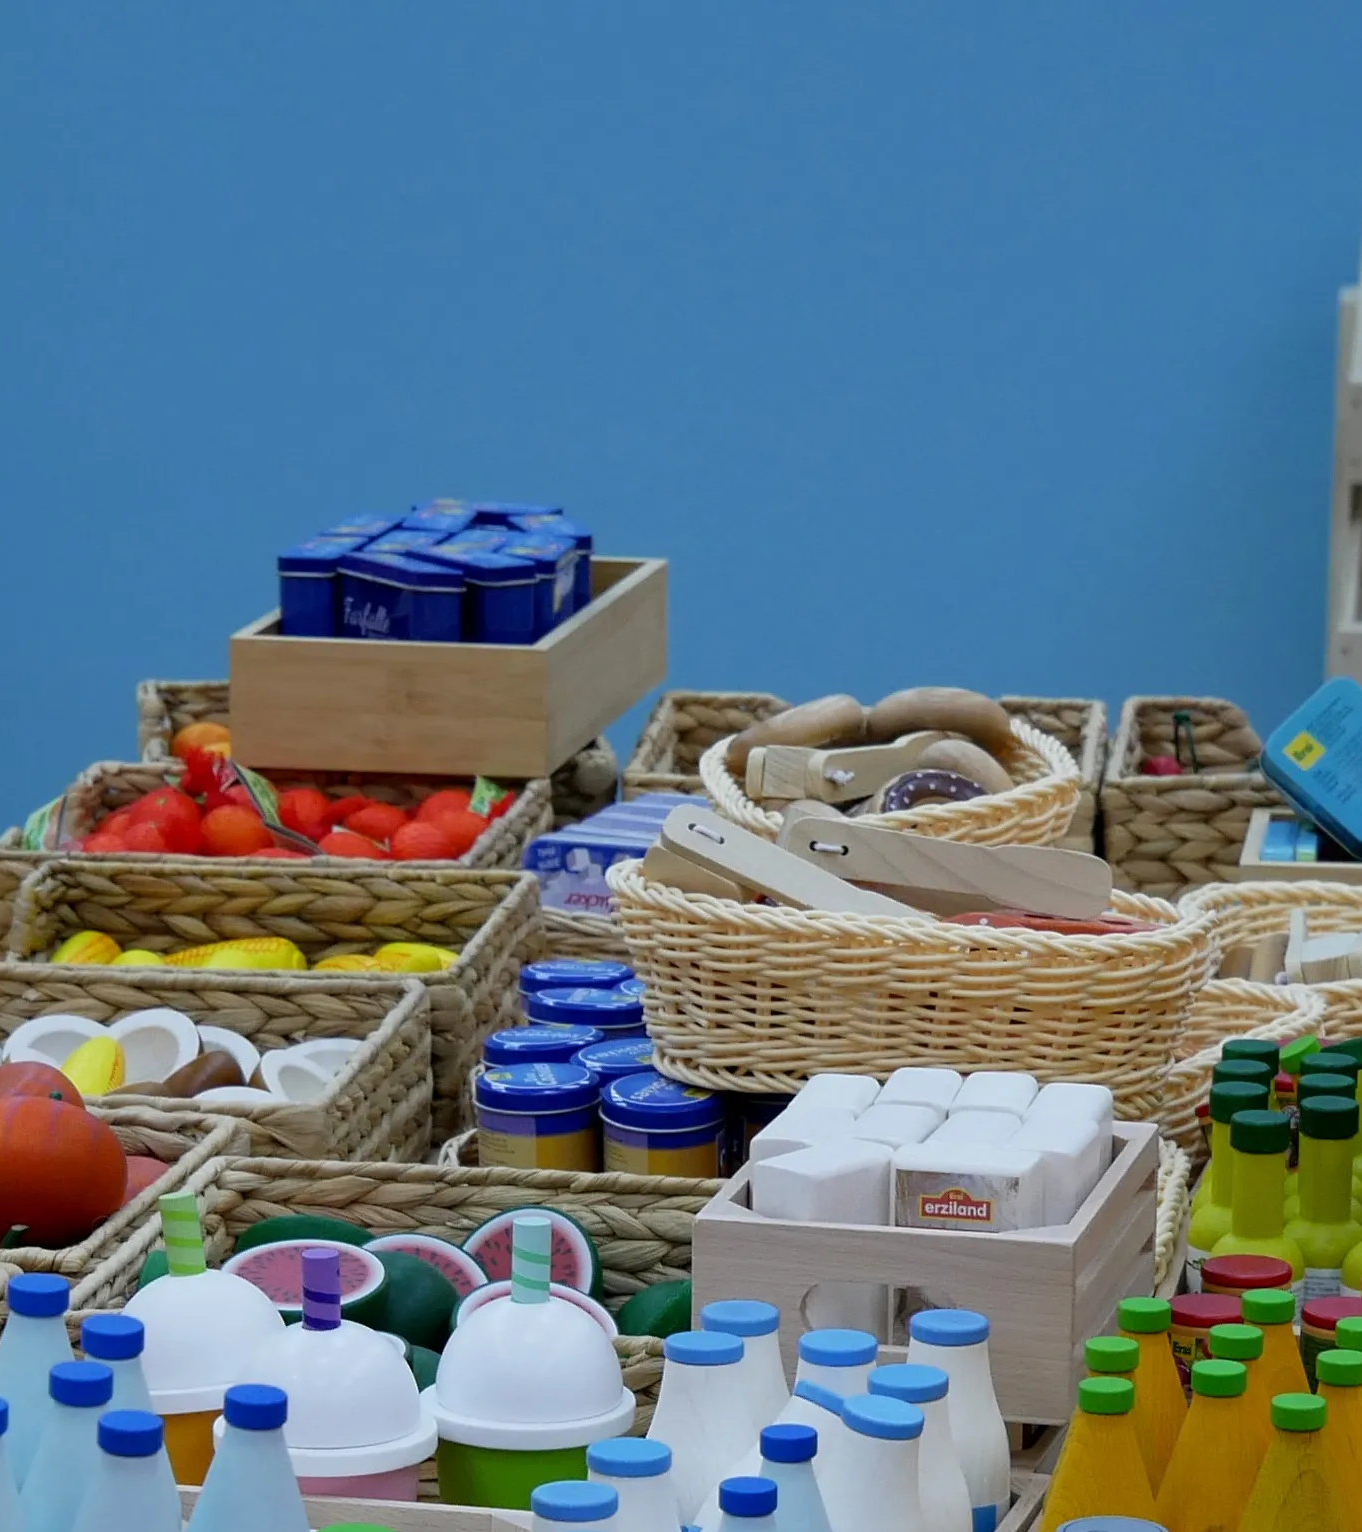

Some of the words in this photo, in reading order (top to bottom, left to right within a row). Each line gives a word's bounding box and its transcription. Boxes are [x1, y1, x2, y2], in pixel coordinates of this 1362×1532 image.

[564, 892, 614, 914] ucker
[924, 1201, 987, 1217] erziland
[1173, 1340, 1192, 1356] Erzi
